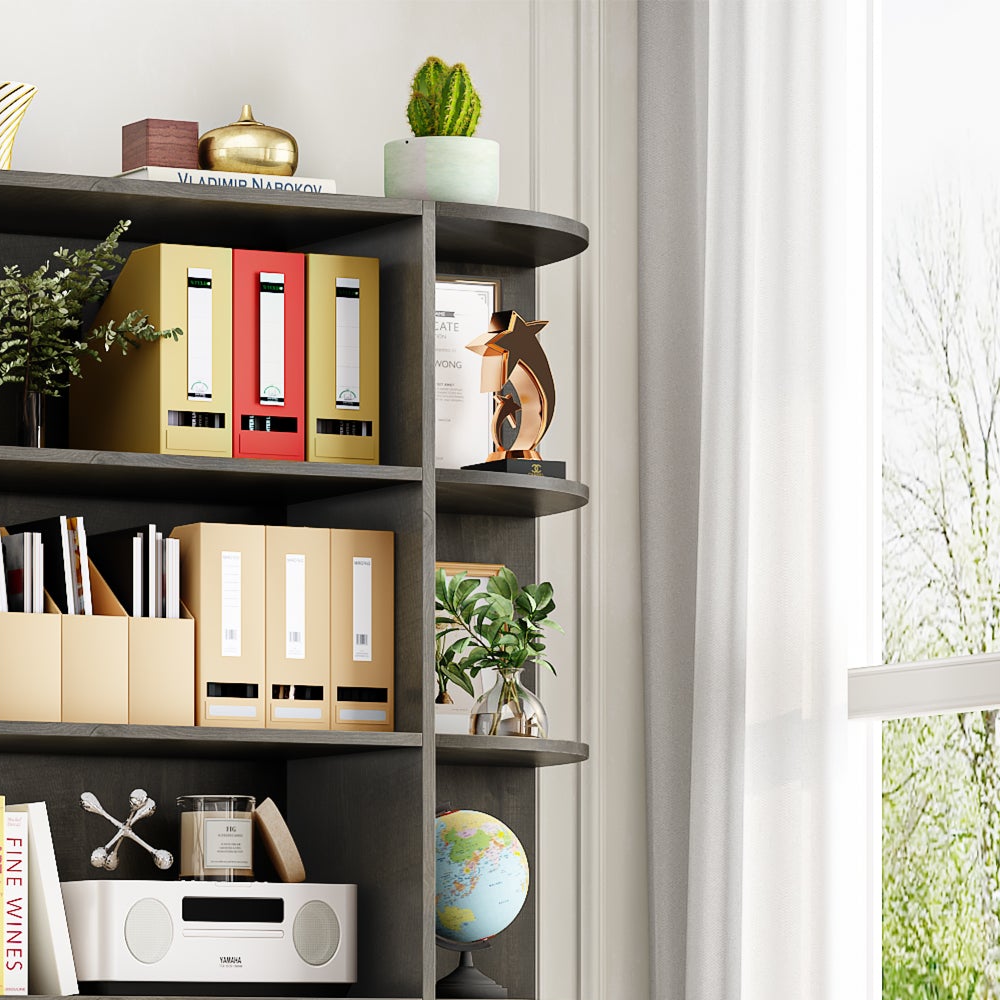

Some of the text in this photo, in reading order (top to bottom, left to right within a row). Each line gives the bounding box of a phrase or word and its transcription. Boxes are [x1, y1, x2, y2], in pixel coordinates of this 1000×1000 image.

[6, 838, 23, 886] FINE
[6, 897, 23, 971] WINES
[219, 956, 242, 964] YAMAHA
